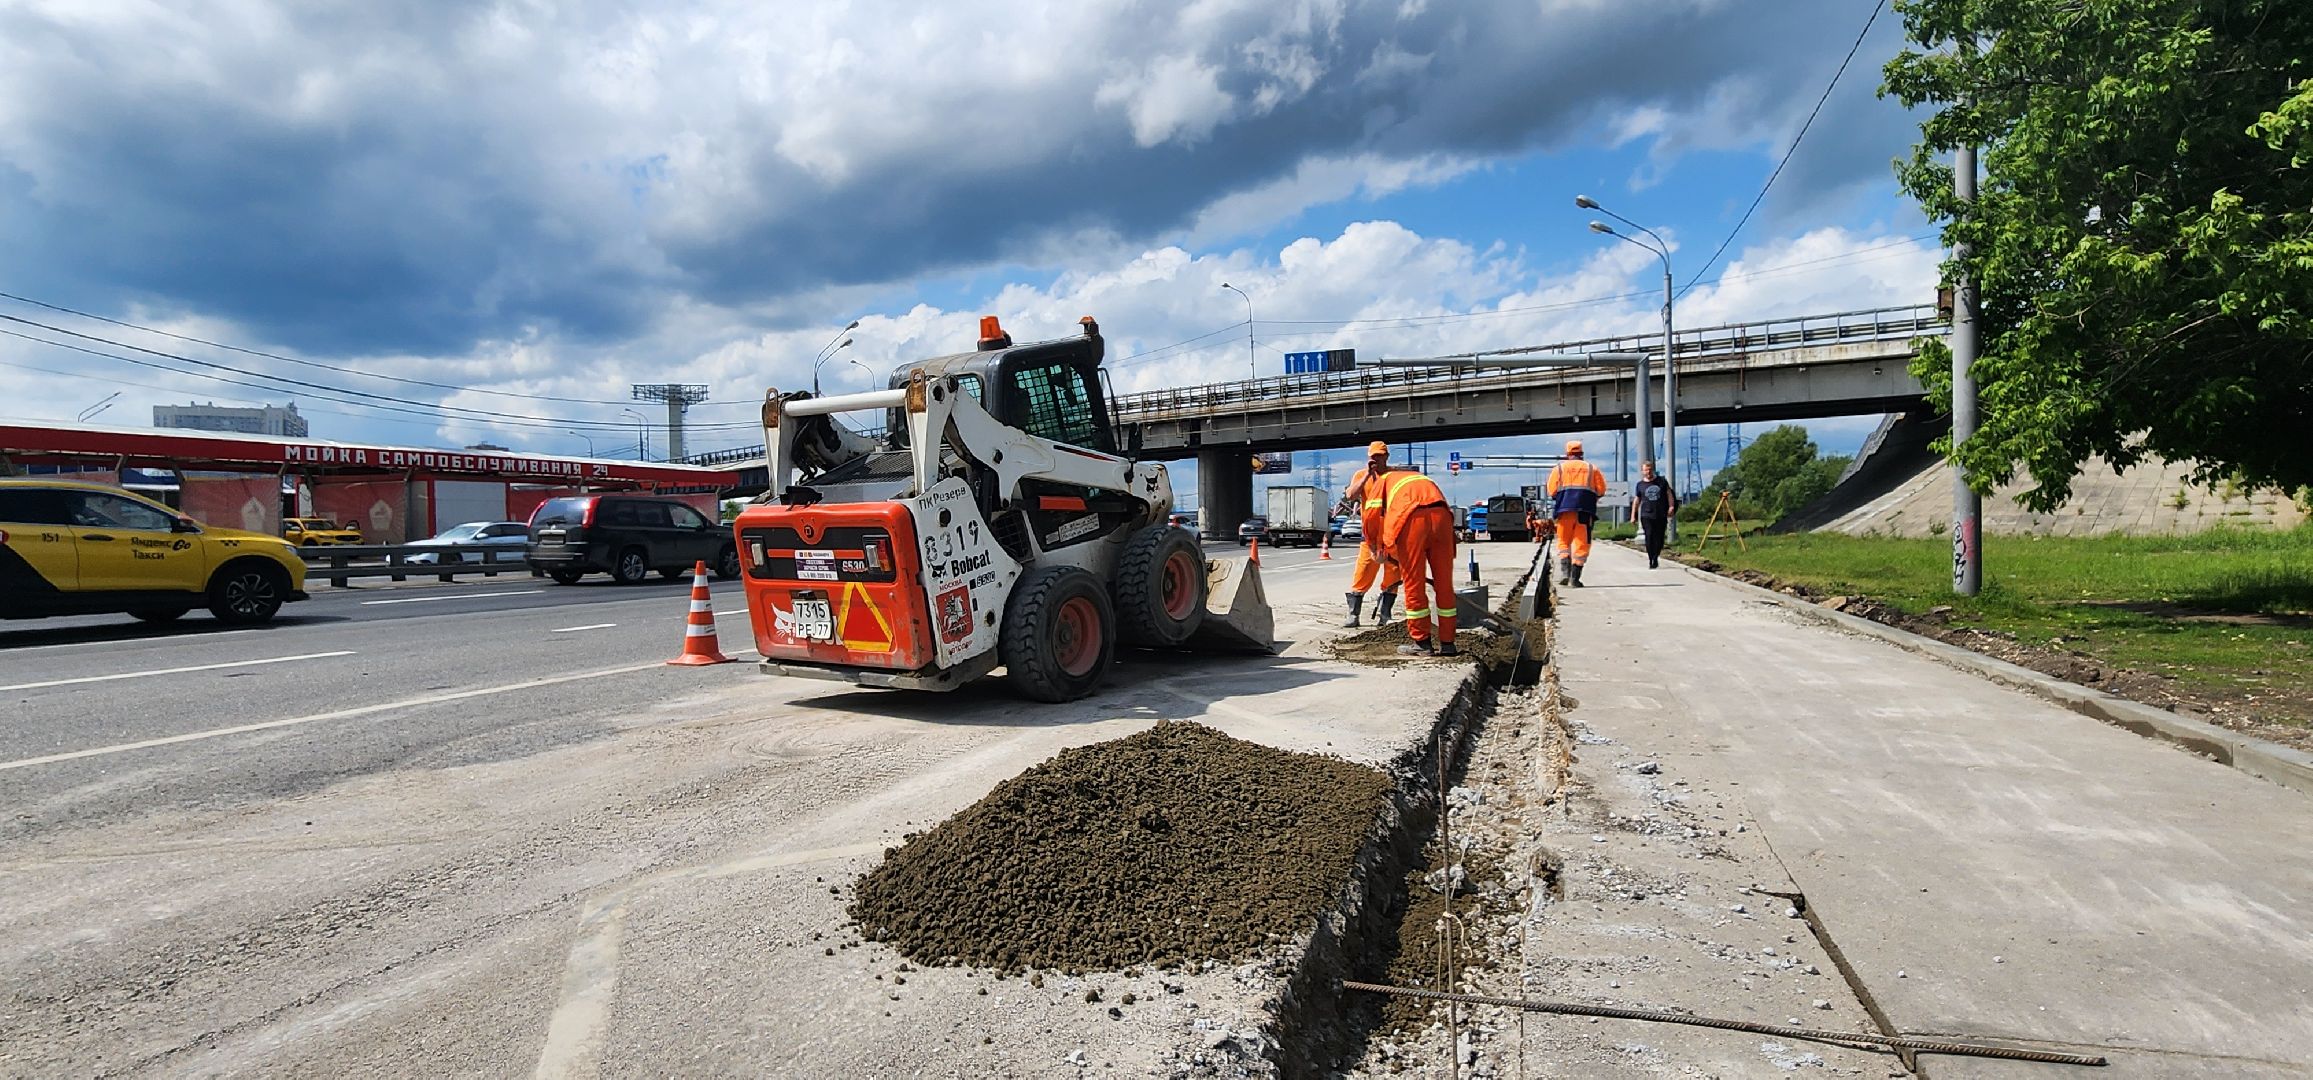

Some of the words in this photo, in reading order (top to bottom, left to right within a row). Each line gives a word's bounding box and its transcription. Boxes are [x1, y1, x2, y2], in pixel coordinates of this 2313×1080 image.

[285, 446, 367, 464] МОЙКА
[378, 451, 582, 475] САМООБСЛУЖИВАНИЯ
[593, 464, 608, 476] 24
[933, 487, 967, 504] Резерв
[41, 533, 60, 542] 151
[131, 536, 171, 549] Яндекс
[172, 539, 192, 551] Go
[924, 520, 979, 561] 8319
[132, 550, 165, 560] Такси
[951, 549, 992, 578] Bobcat
[940, 579, 963, 592] МОСКВА
[796, 603, 826, 619] 7315
[818, 624, 829, 636] 77
